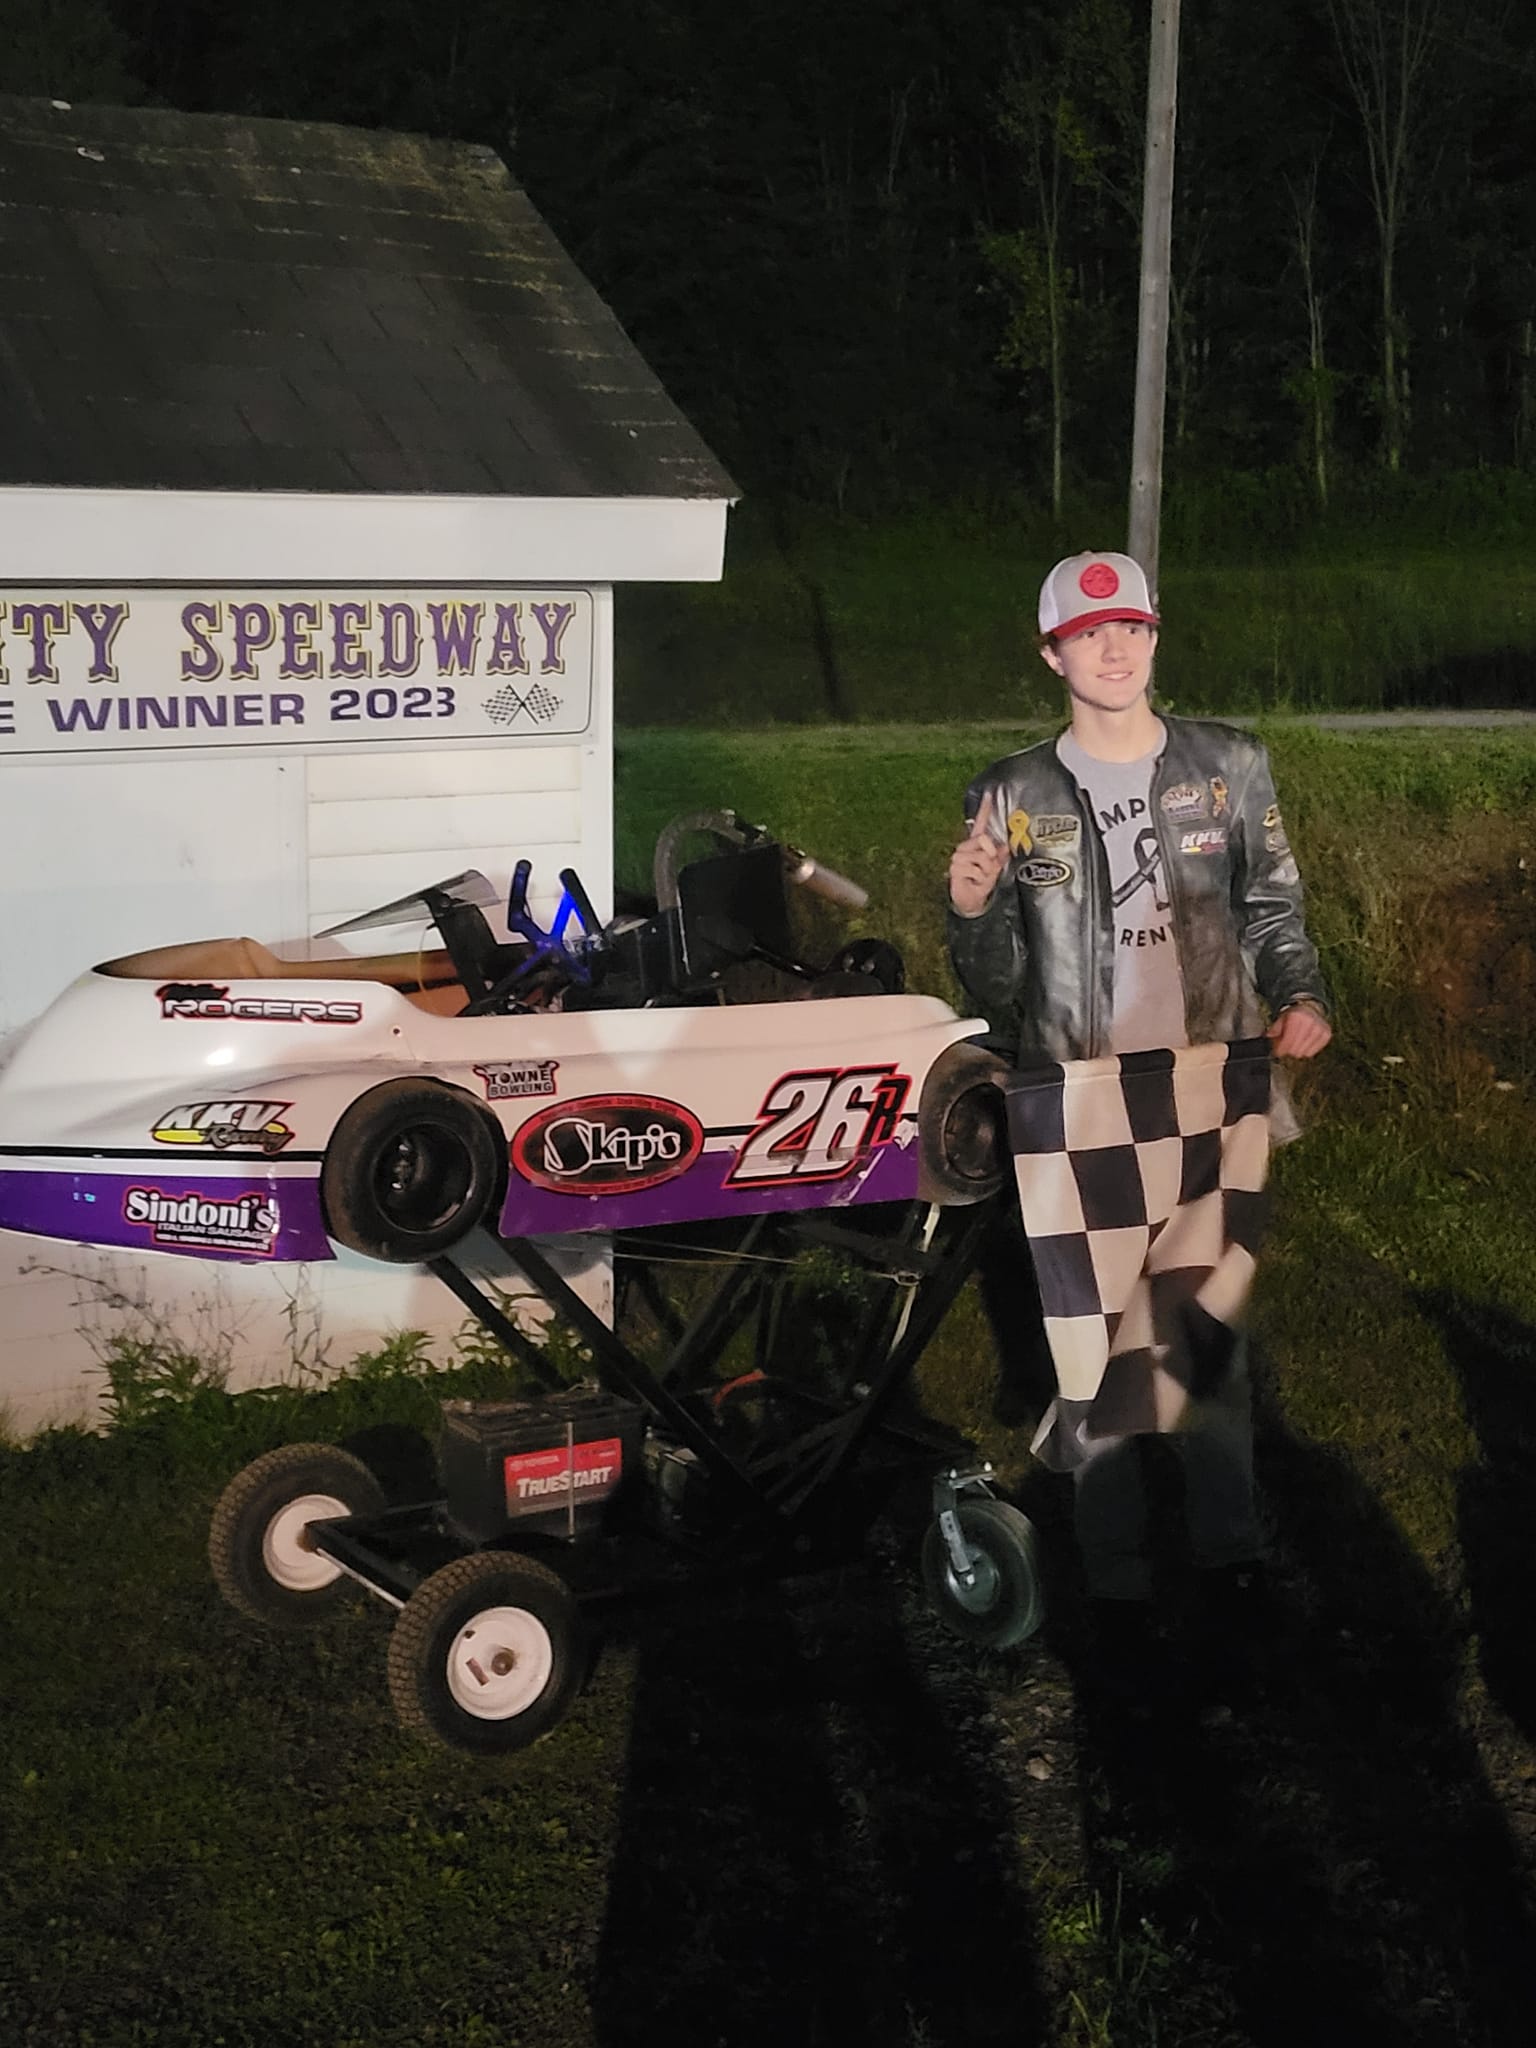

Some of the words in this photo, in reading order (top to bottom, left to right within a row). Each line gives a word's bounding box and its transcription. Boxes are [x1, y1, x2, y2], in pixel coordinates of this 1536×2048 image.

[179, 600, 575, 682] SPEEDWAY
[47, 692, 304, 733] WINNER
[330, 686, 455, 721] 2023
[1098, 798, 1146, 834] MP
[162, 998, 361, 1023] ROGERS
[488, 1069, 550, 1085] TOWNE
[490, 1081, 552, 1097] BOWLING
[544, 1116, 681, 1177] Skip's
[126, 1189, 276, 1233] Sindoni's
